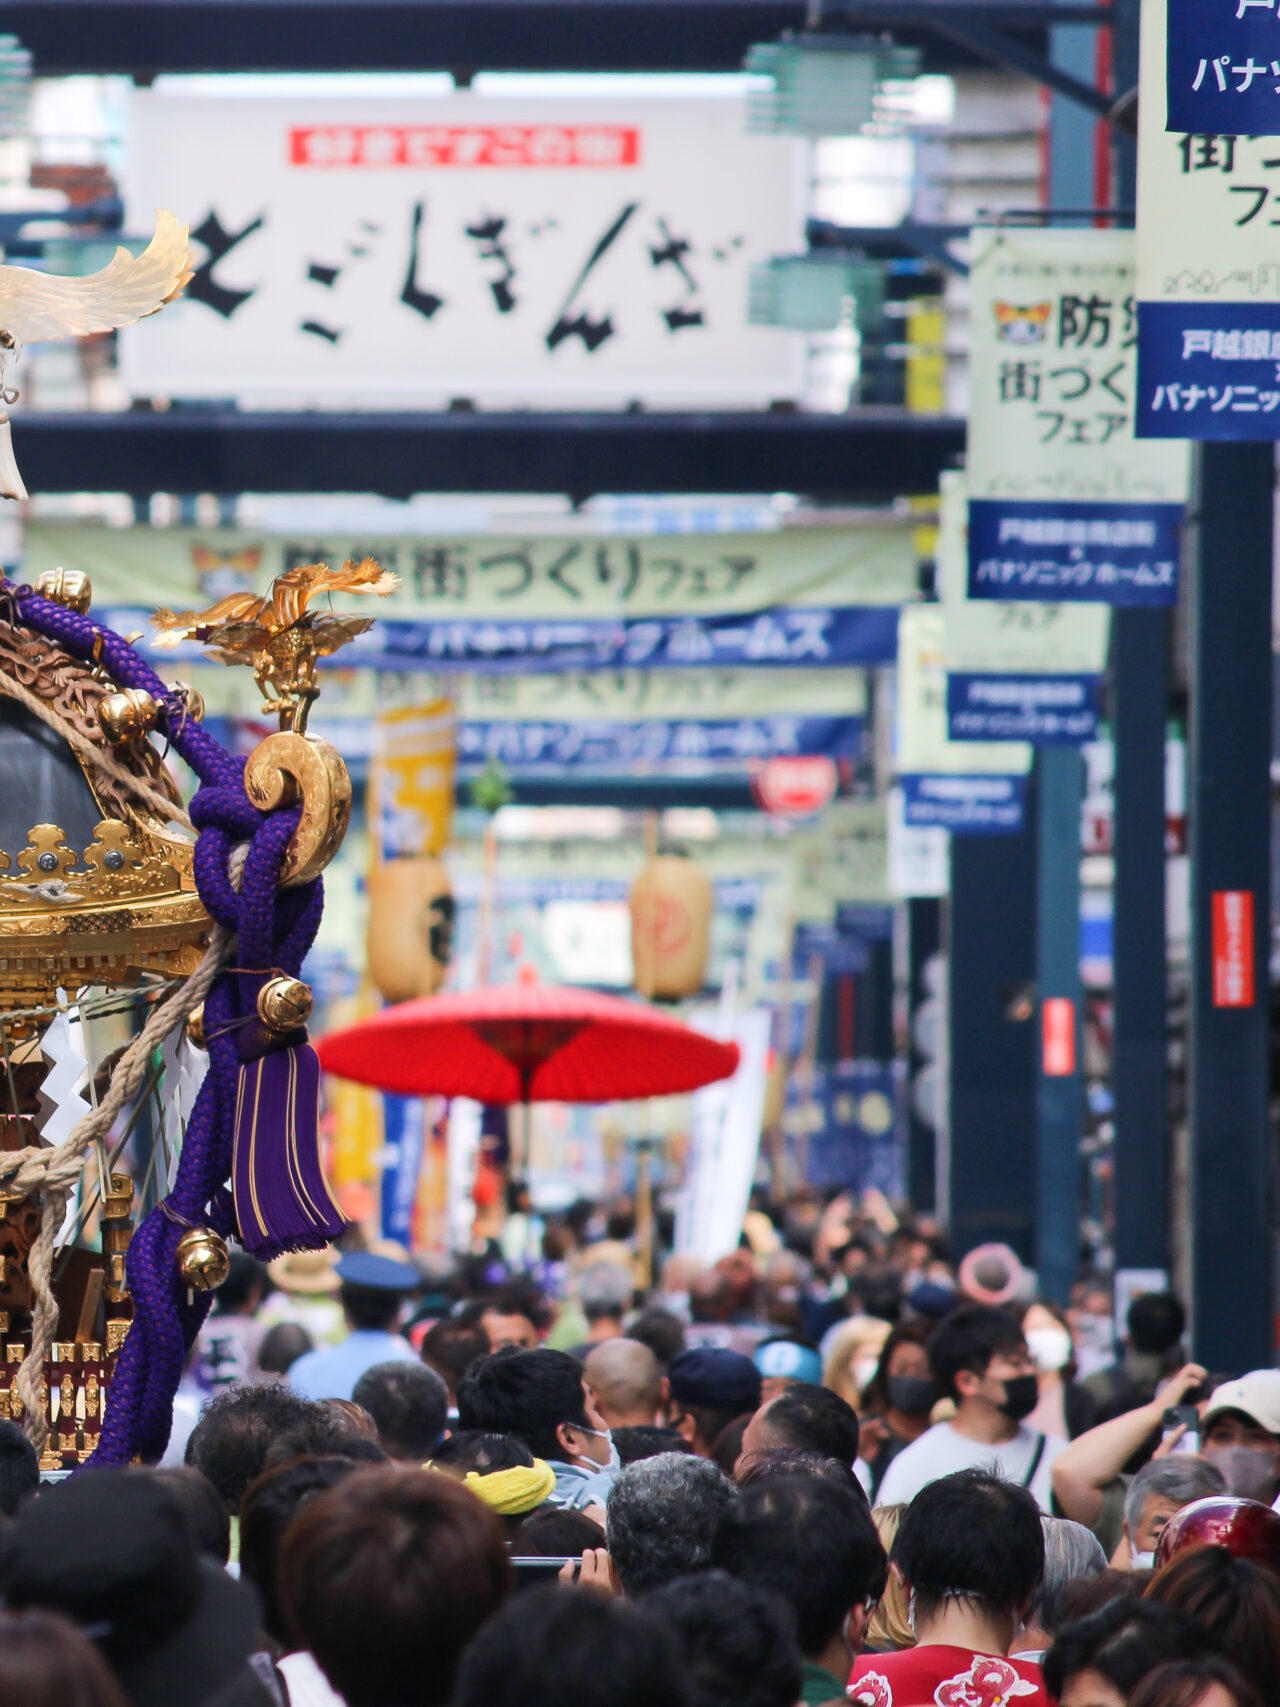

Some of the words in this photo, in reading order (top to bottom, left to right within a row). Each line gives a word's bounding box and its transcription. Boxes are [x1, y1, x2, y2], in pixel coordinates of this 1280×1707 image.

[1192, 56, 1280, 94] パナ
[1228, 185, 1280, 227] フ
[186, 200, 743, 352] とごしぎんざ
[1036, 411, 1128, 444] フェア
